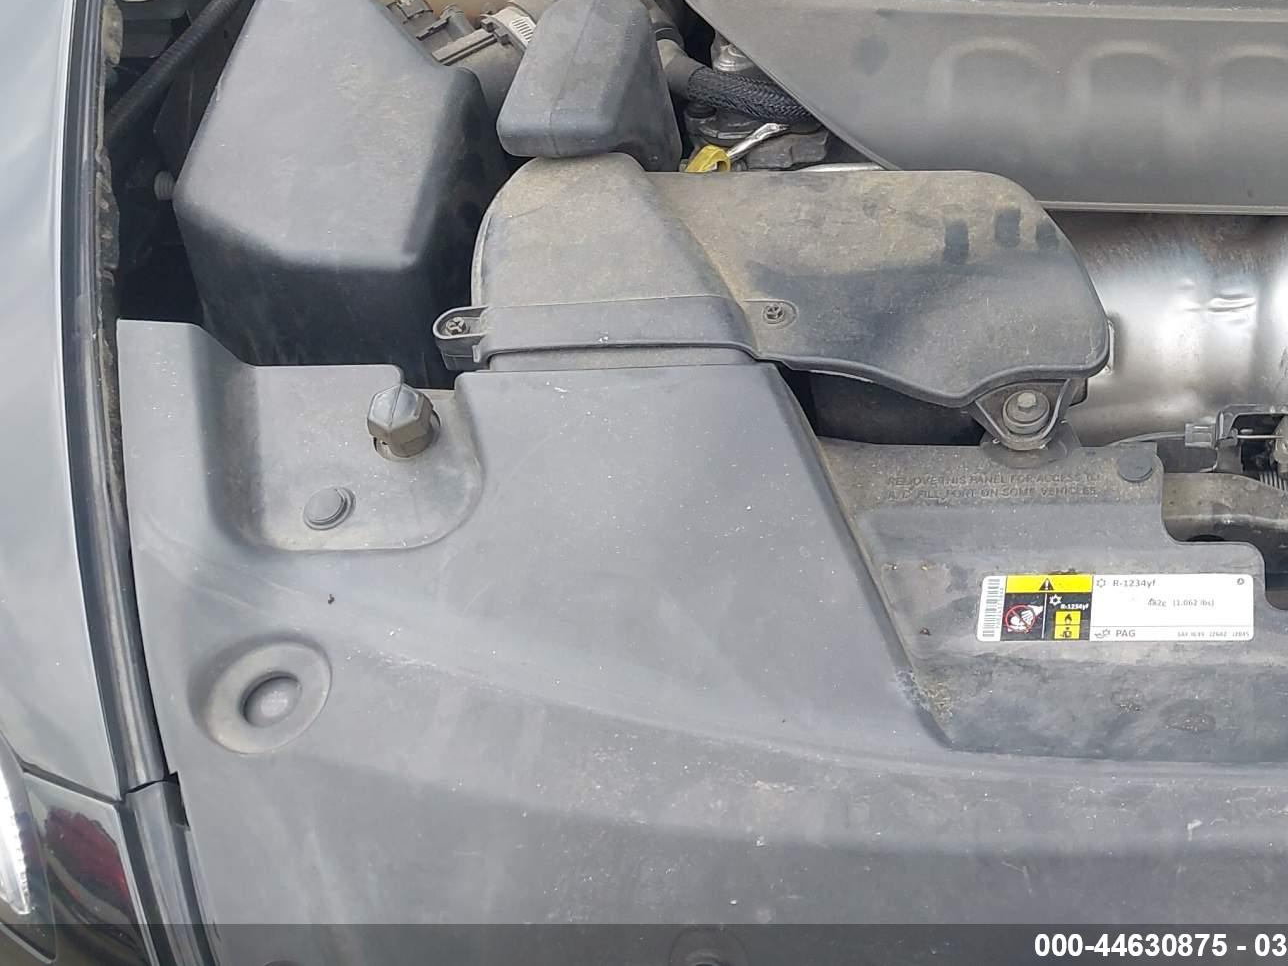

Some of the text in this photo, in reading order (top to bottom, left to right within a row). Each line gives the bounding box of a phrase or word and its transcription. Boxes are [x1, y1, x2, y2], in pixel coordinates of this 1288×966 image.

[970, 474, 1005, 484] PANEL
[1010, 474, 1035, 484] FOR
[1036, 473, 1081, 484] ACCESS
[916, 488, 941, 499] FILL
[981, 488, 999, 498] ON
[1002, 487, 1034, 497] SOME
[1041, 486, 1096, 497] VEHICLES
[1113, 579, 1156, 589] R-1234yf
[1115, 630, 1136, 638] PAG
